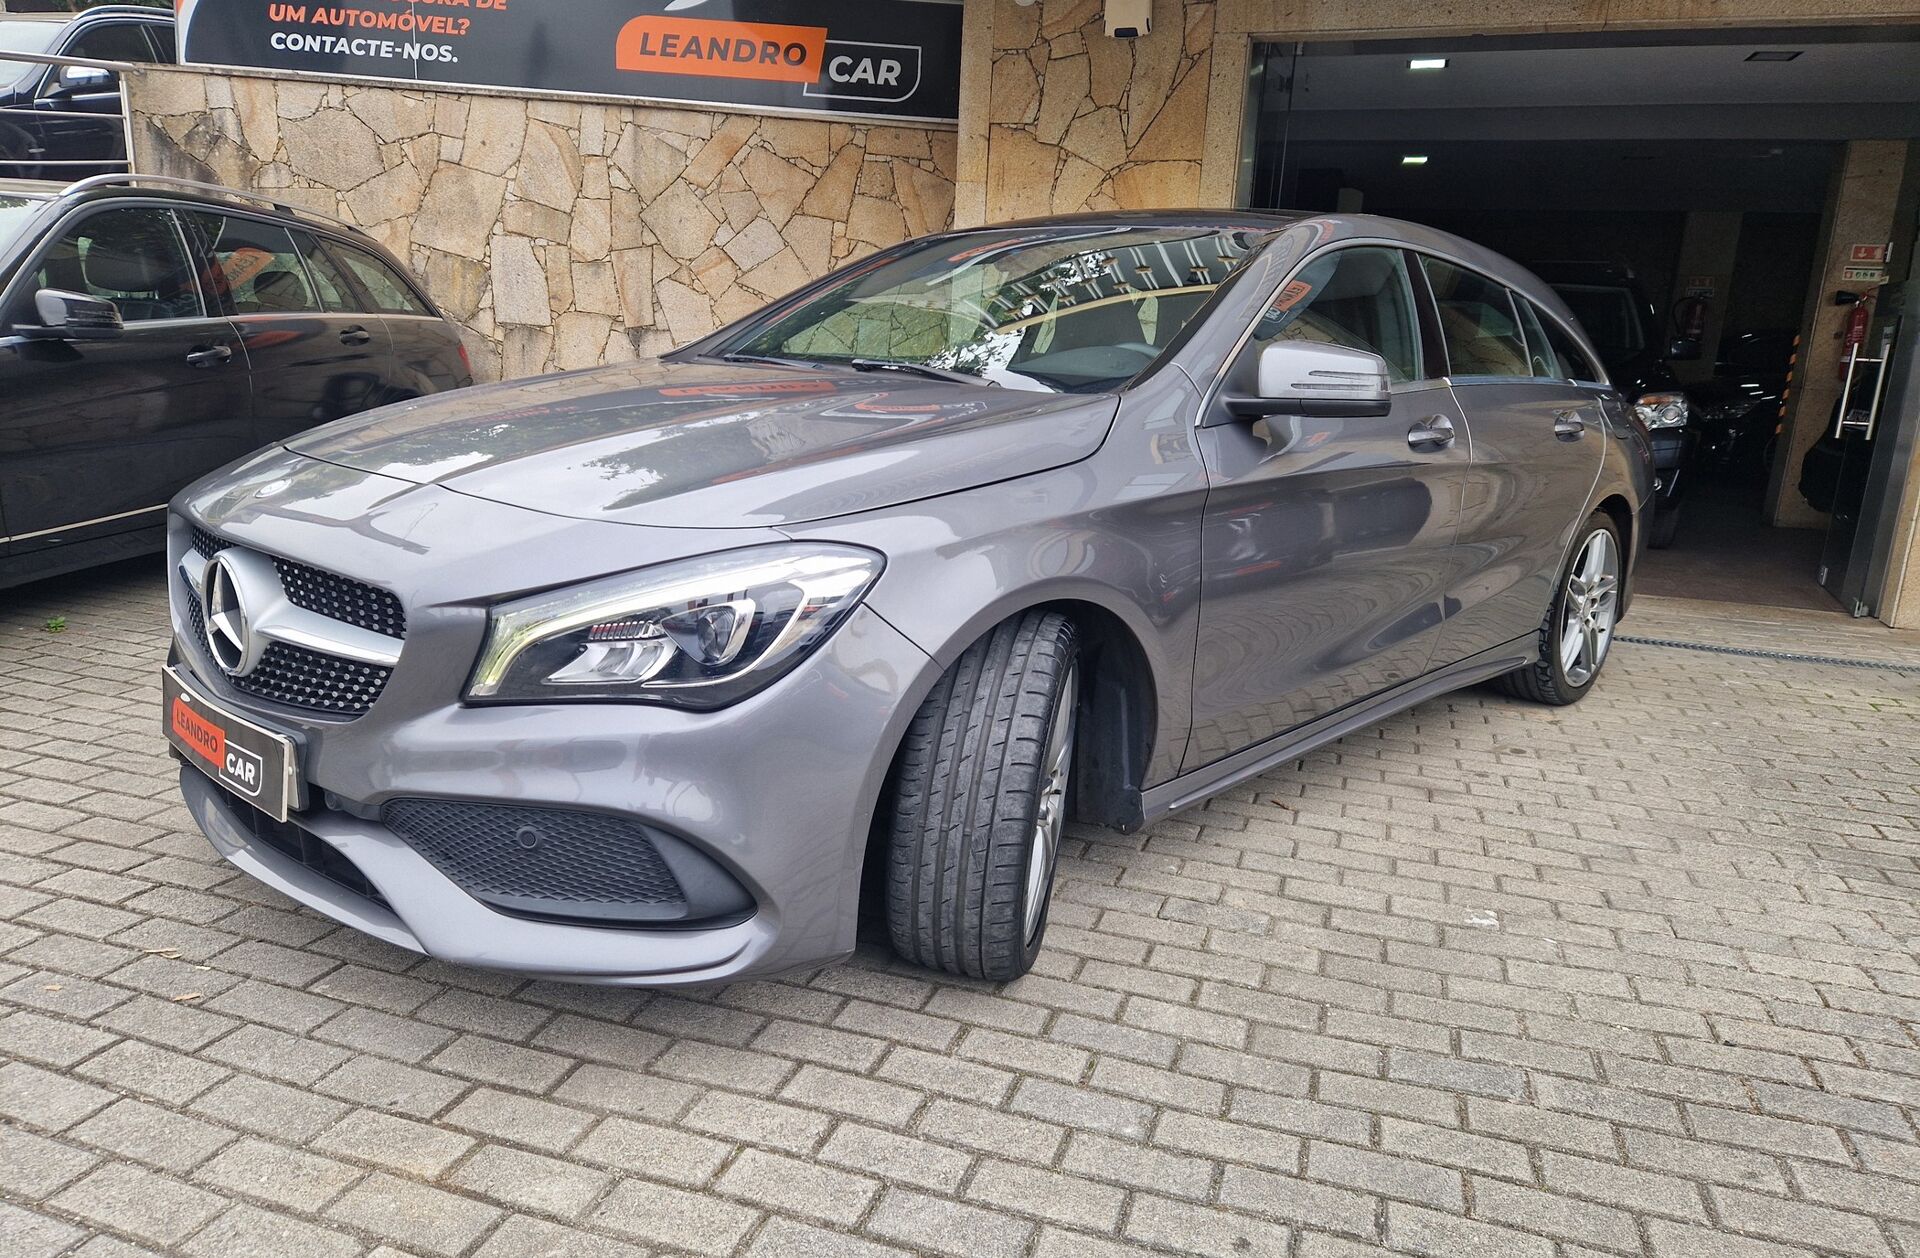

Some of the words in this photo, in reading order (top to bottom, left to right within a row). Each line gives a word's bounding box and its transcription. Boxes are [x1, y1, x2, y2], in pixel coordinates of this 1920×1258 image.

[269, 3, 306, 23] UM
[311, 7, 470, 35] AUTOMÓVEL?
[270, 32, 459, 63] CONTACTE-NOS.
[639, 31, 808, 67] LEANDRO
[828, 55, 902, 87] CAR
[176, 708, 218, 753] LEANDRO
[226, 752, 256, 785] CAR
